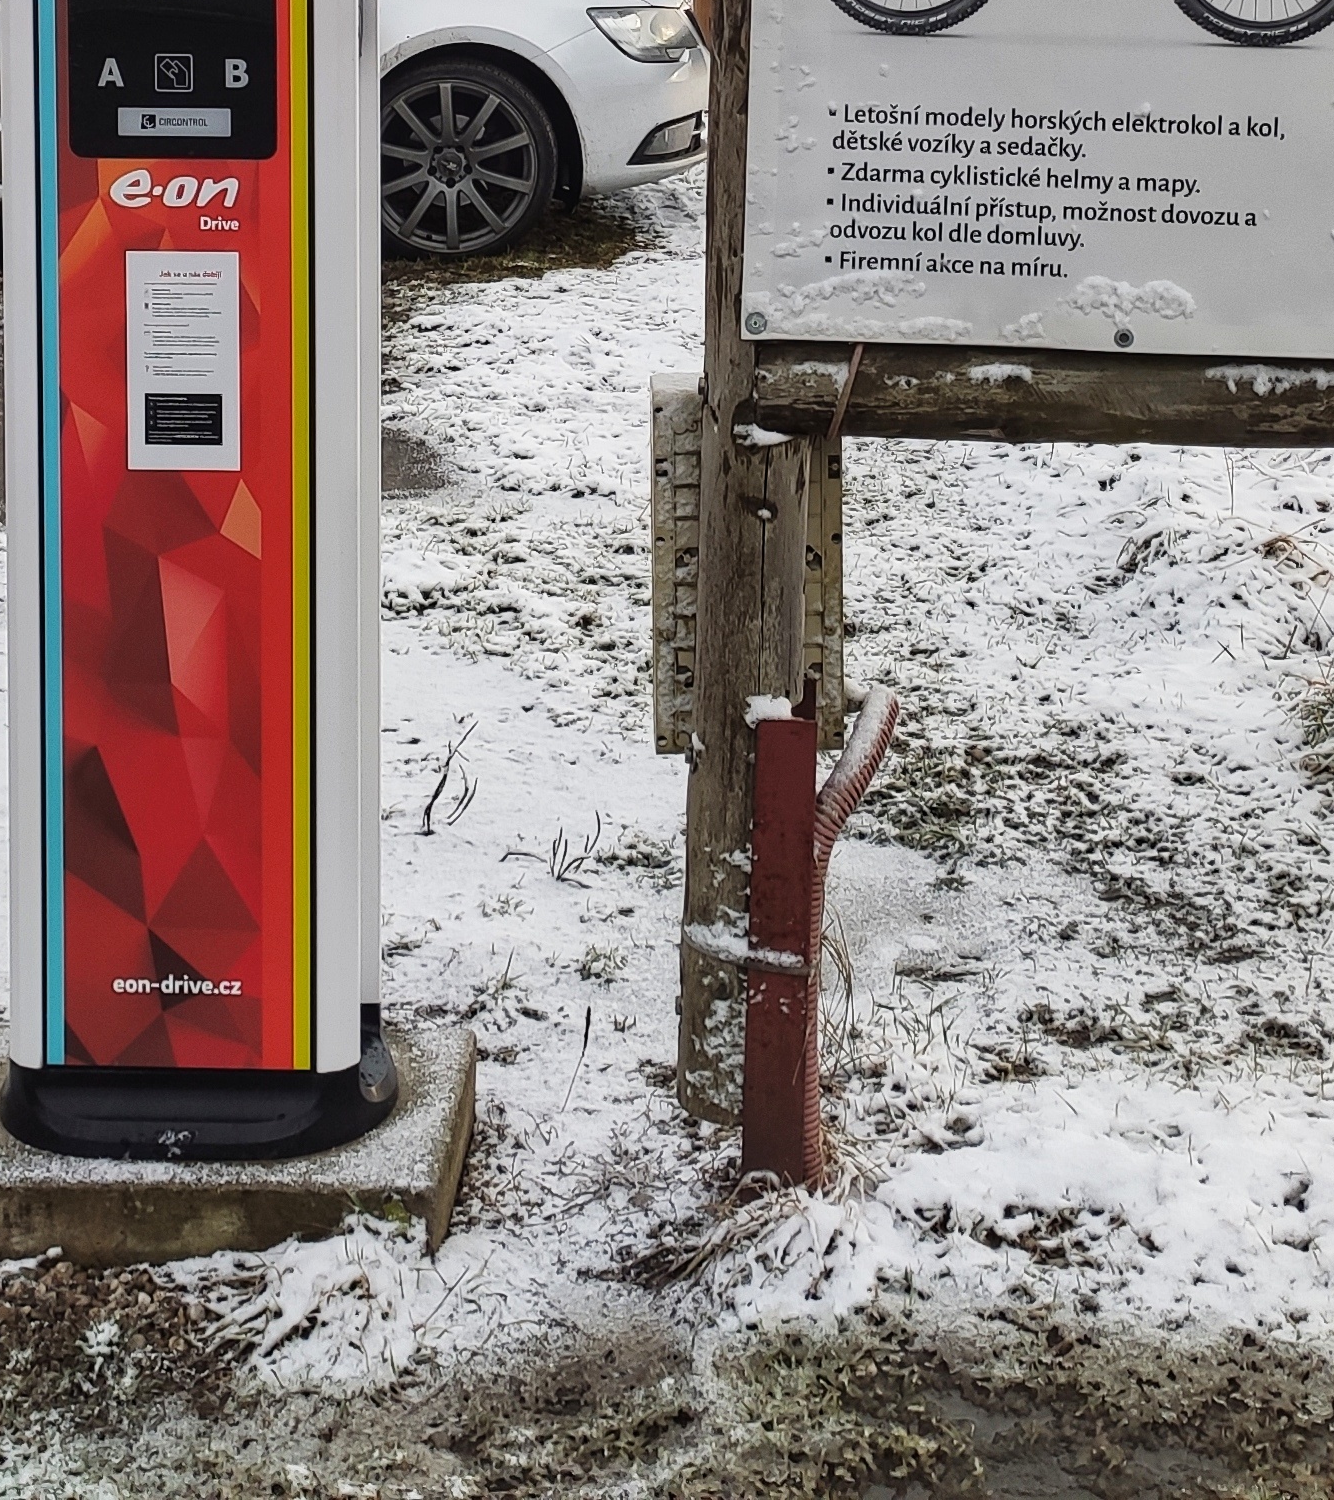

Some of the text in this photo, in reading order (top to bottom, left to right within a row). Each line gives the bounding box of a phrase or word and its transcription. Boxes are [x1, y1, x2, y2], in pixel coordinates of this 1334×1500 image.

[97, 57, 250, 88] A B
[158, 117, 208, 127] CIRCONTROL
[844, 103, 1285, 141] Letošní modely horských elektrokol a kol,
[832, 129, 1086, 162] dětské vozíky a sedačky.
[840, 161, 1201, 198] Zdarma cyklistické helmy a mapy.
[199, 216, 240, 231] Drive
[841, 192, 1258, 227] Individuální přístup, možnost dovozu a
[829, 218, 1085, 252] odvozu kol dle domluvy.
[839, 250, 1068, 279] Firemní akce na míru.
[112, 974, 243, 996] eon-drive.cz
